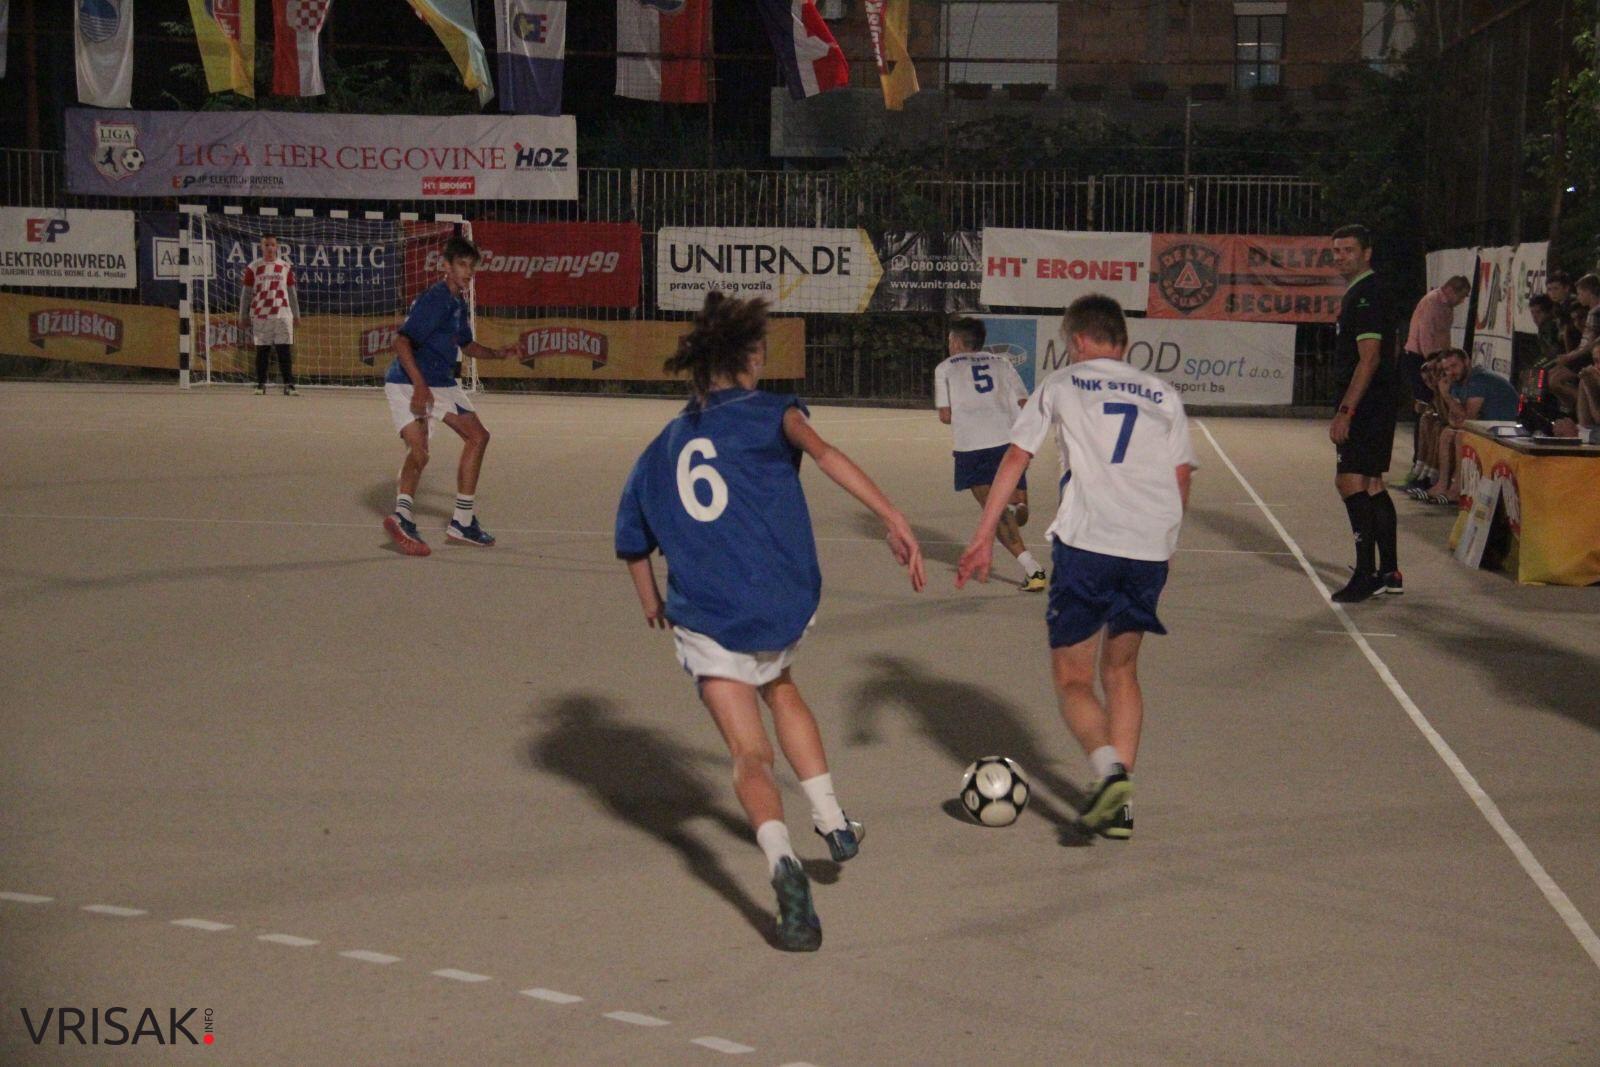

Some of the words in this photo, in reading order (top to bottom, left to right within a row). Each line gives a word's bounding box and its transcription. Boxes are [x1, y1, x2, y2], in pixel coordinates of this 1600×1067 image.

[100, 128, 131, 140] LIGA
[175, 142, 252, 168] LIGA
[264, 143, 507, 170] HERCEGOVINE
[26, 218, 70, 243] EP
[0, 251, 127, 269] LEKTROPRIVREDA
[669, 244, 852, 276] UNITRADE
[911, 261, 933, 272] 080
[935, 261, 959, 272] 080
[987, 256, 1022, 278] HT
[1036, 257, 1138, 282] ERONET
[669, 281, 705, 291] pravac
[707, 280, 739, 292] Vašeg
[741, 280, 773, 291] vozila
[1225, 293, 1342, 315] SECURIT
[37, 310, 116, 340] Ožujsko
[527, 328, 601, 356] Ožujsko
[1042, 339, 1182, 374] MOD
[1184, 356, 1247, 380] sport
[1249, 366, 1284, 379] d.o.o.
[971, 364, 994, 394] 5
[1071, 374, 1102, 391] HNK
[1107, 381, 1164, 404] STOLAC
[1103, 402, 1139, 463] 7
[676, 437, 729, 522] 6
